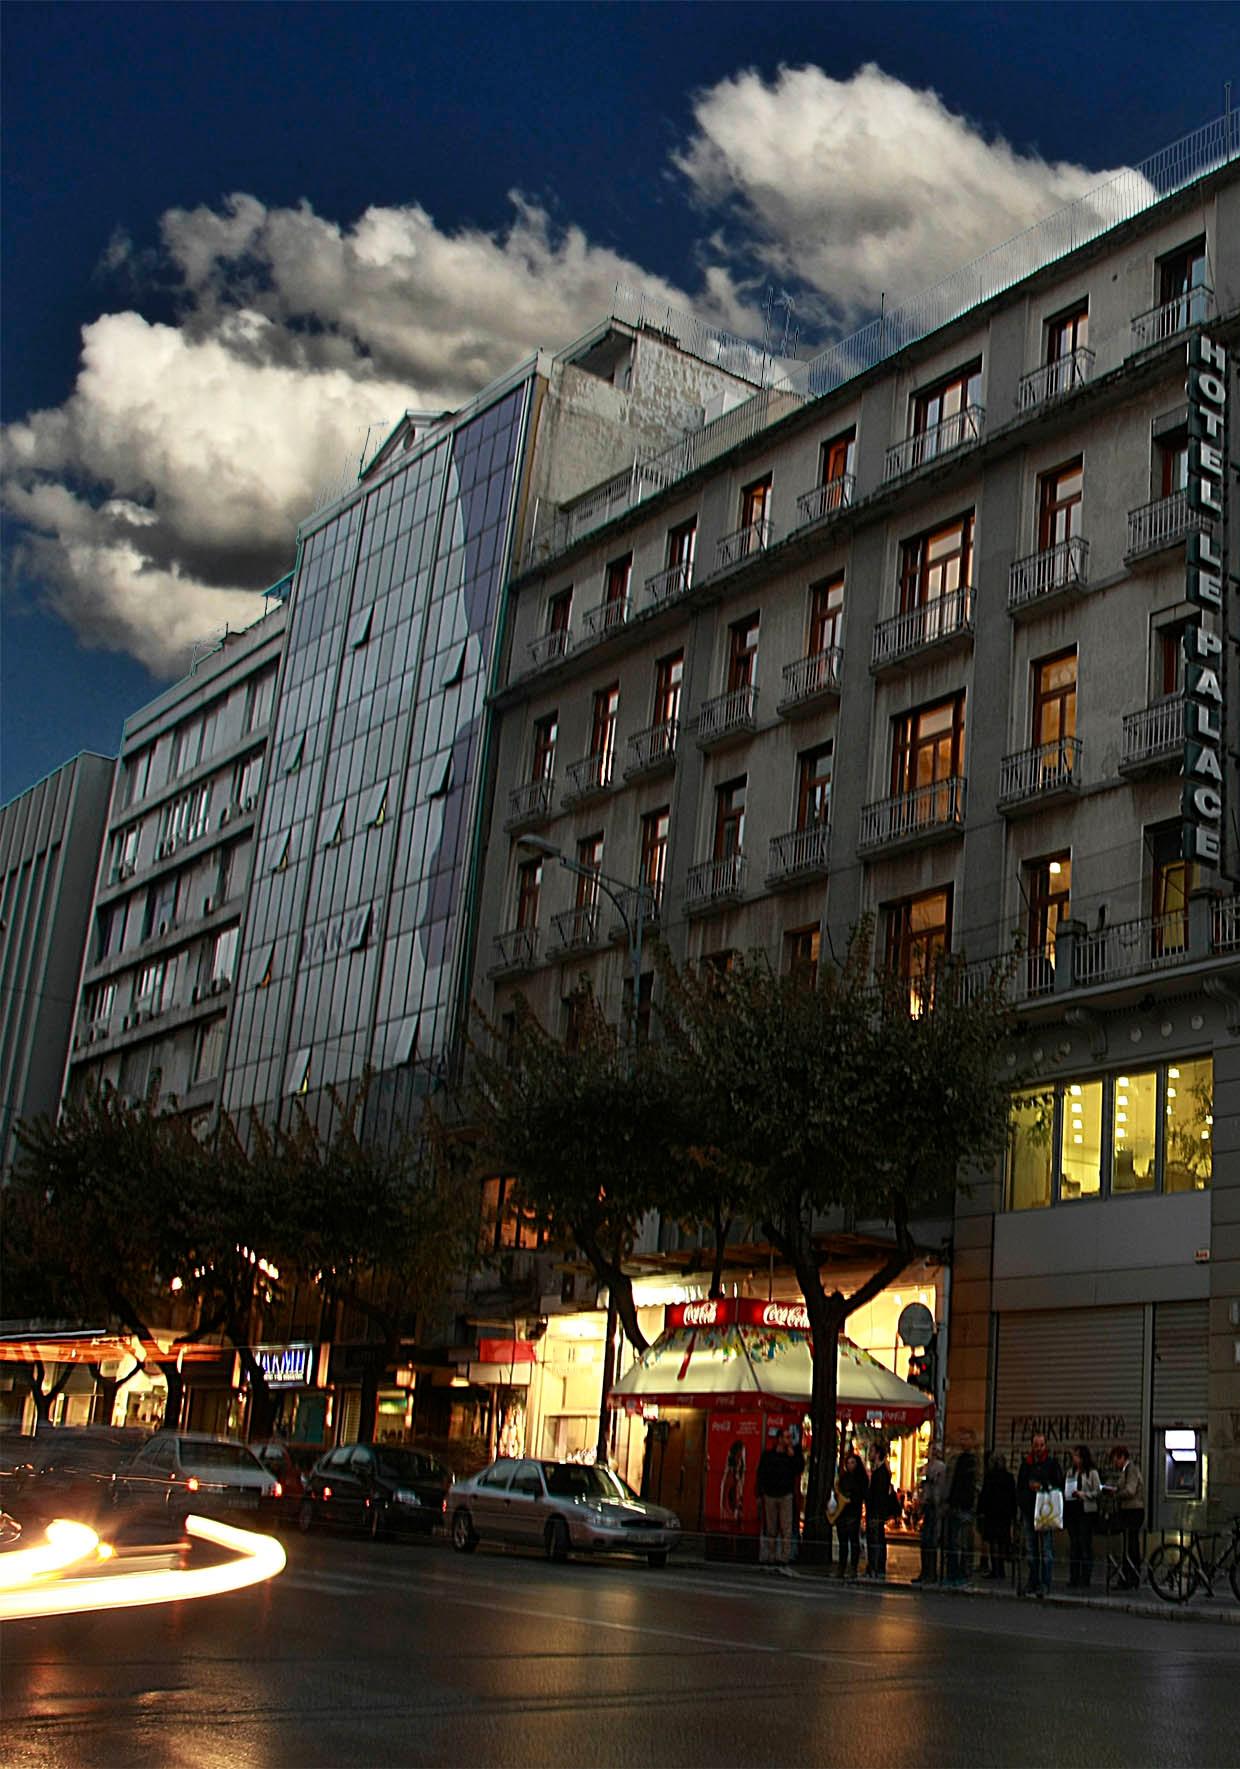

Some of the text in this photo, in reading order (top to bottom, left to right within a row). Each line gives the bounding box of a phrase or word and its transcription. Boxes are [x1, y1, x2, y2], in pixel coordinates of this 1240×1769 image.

[1194, 335, 1226, 861] HOTEL LE PALACE
